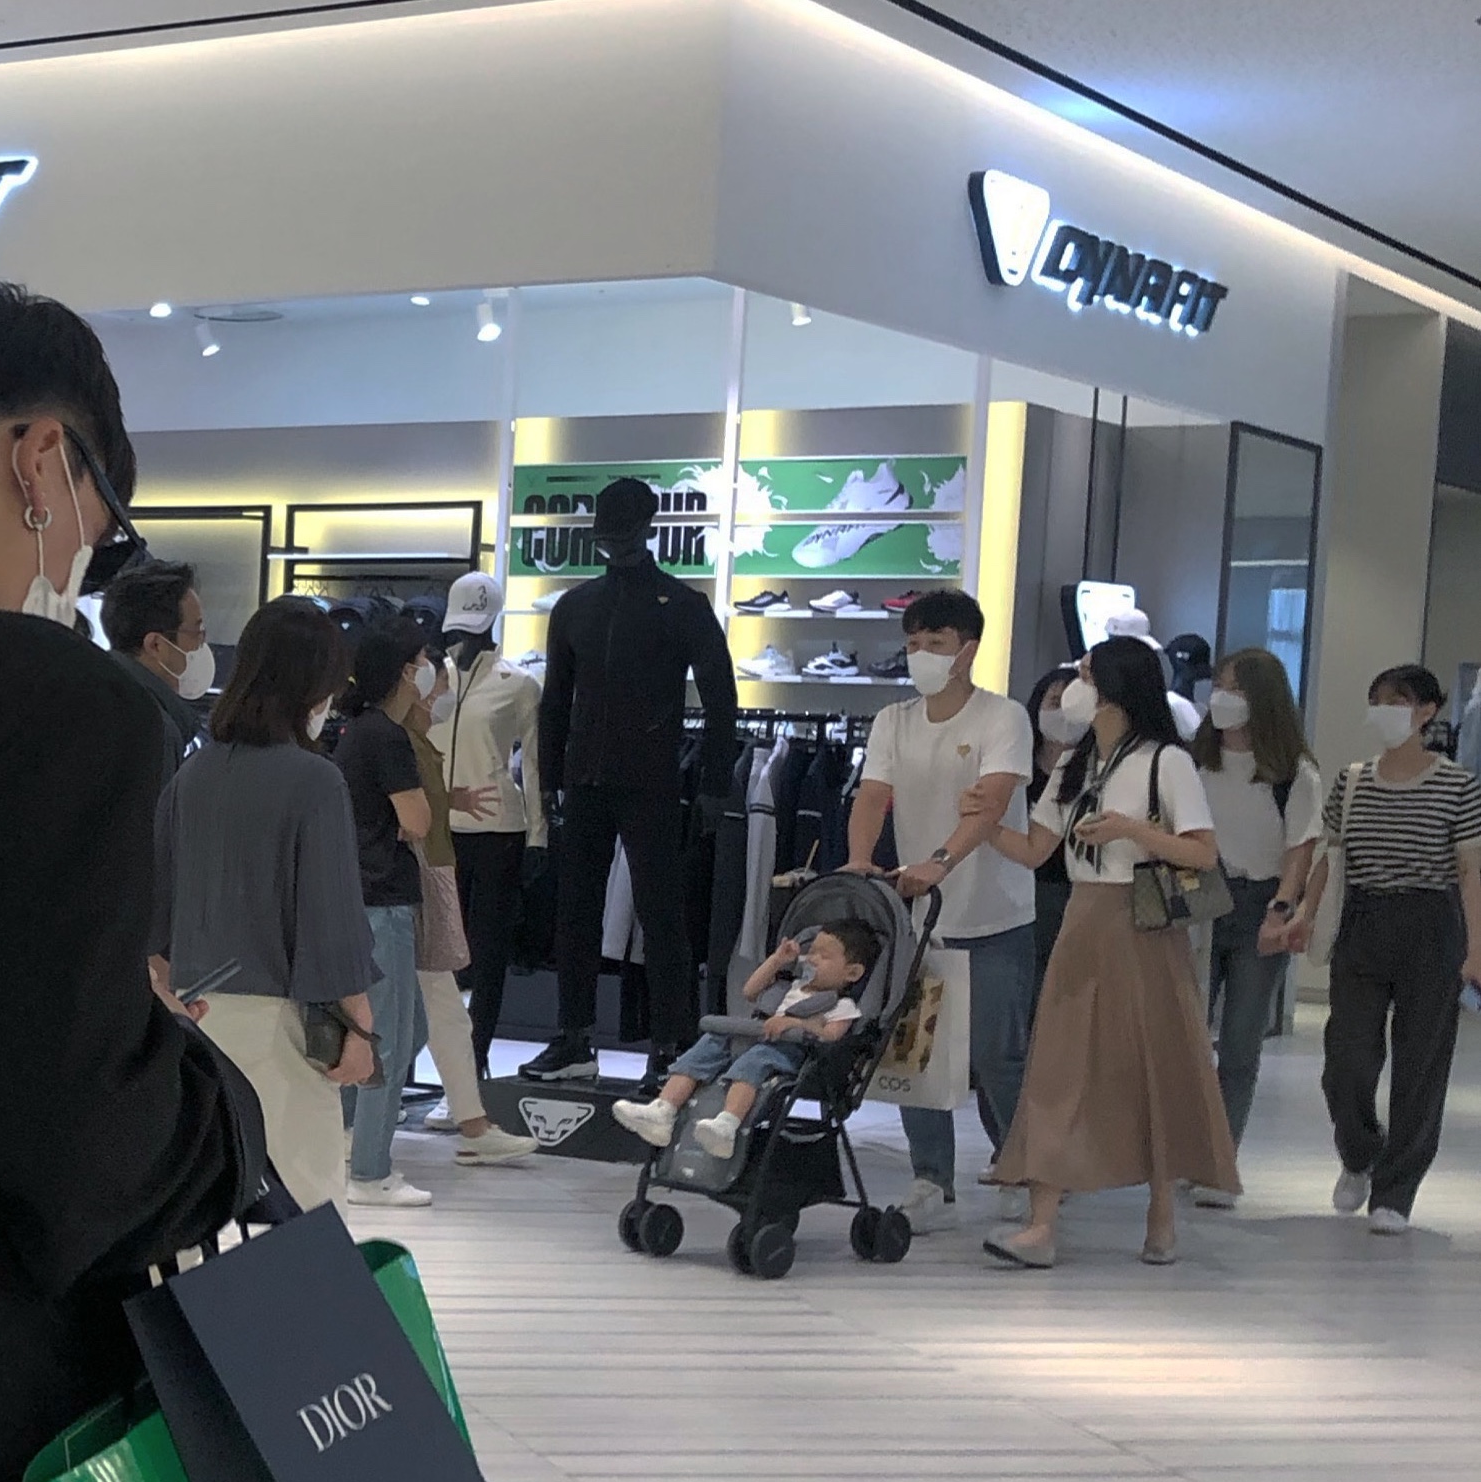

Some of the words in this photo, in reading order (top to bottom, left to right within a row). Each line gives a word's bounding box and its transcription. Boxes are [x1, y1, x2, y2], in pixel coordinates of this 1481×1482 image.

[1032, 219, 1229, 337] DYNAFIT
[878, 1075, 911, 1092] COS
[296, 1372, 393, 1452] DIOR
